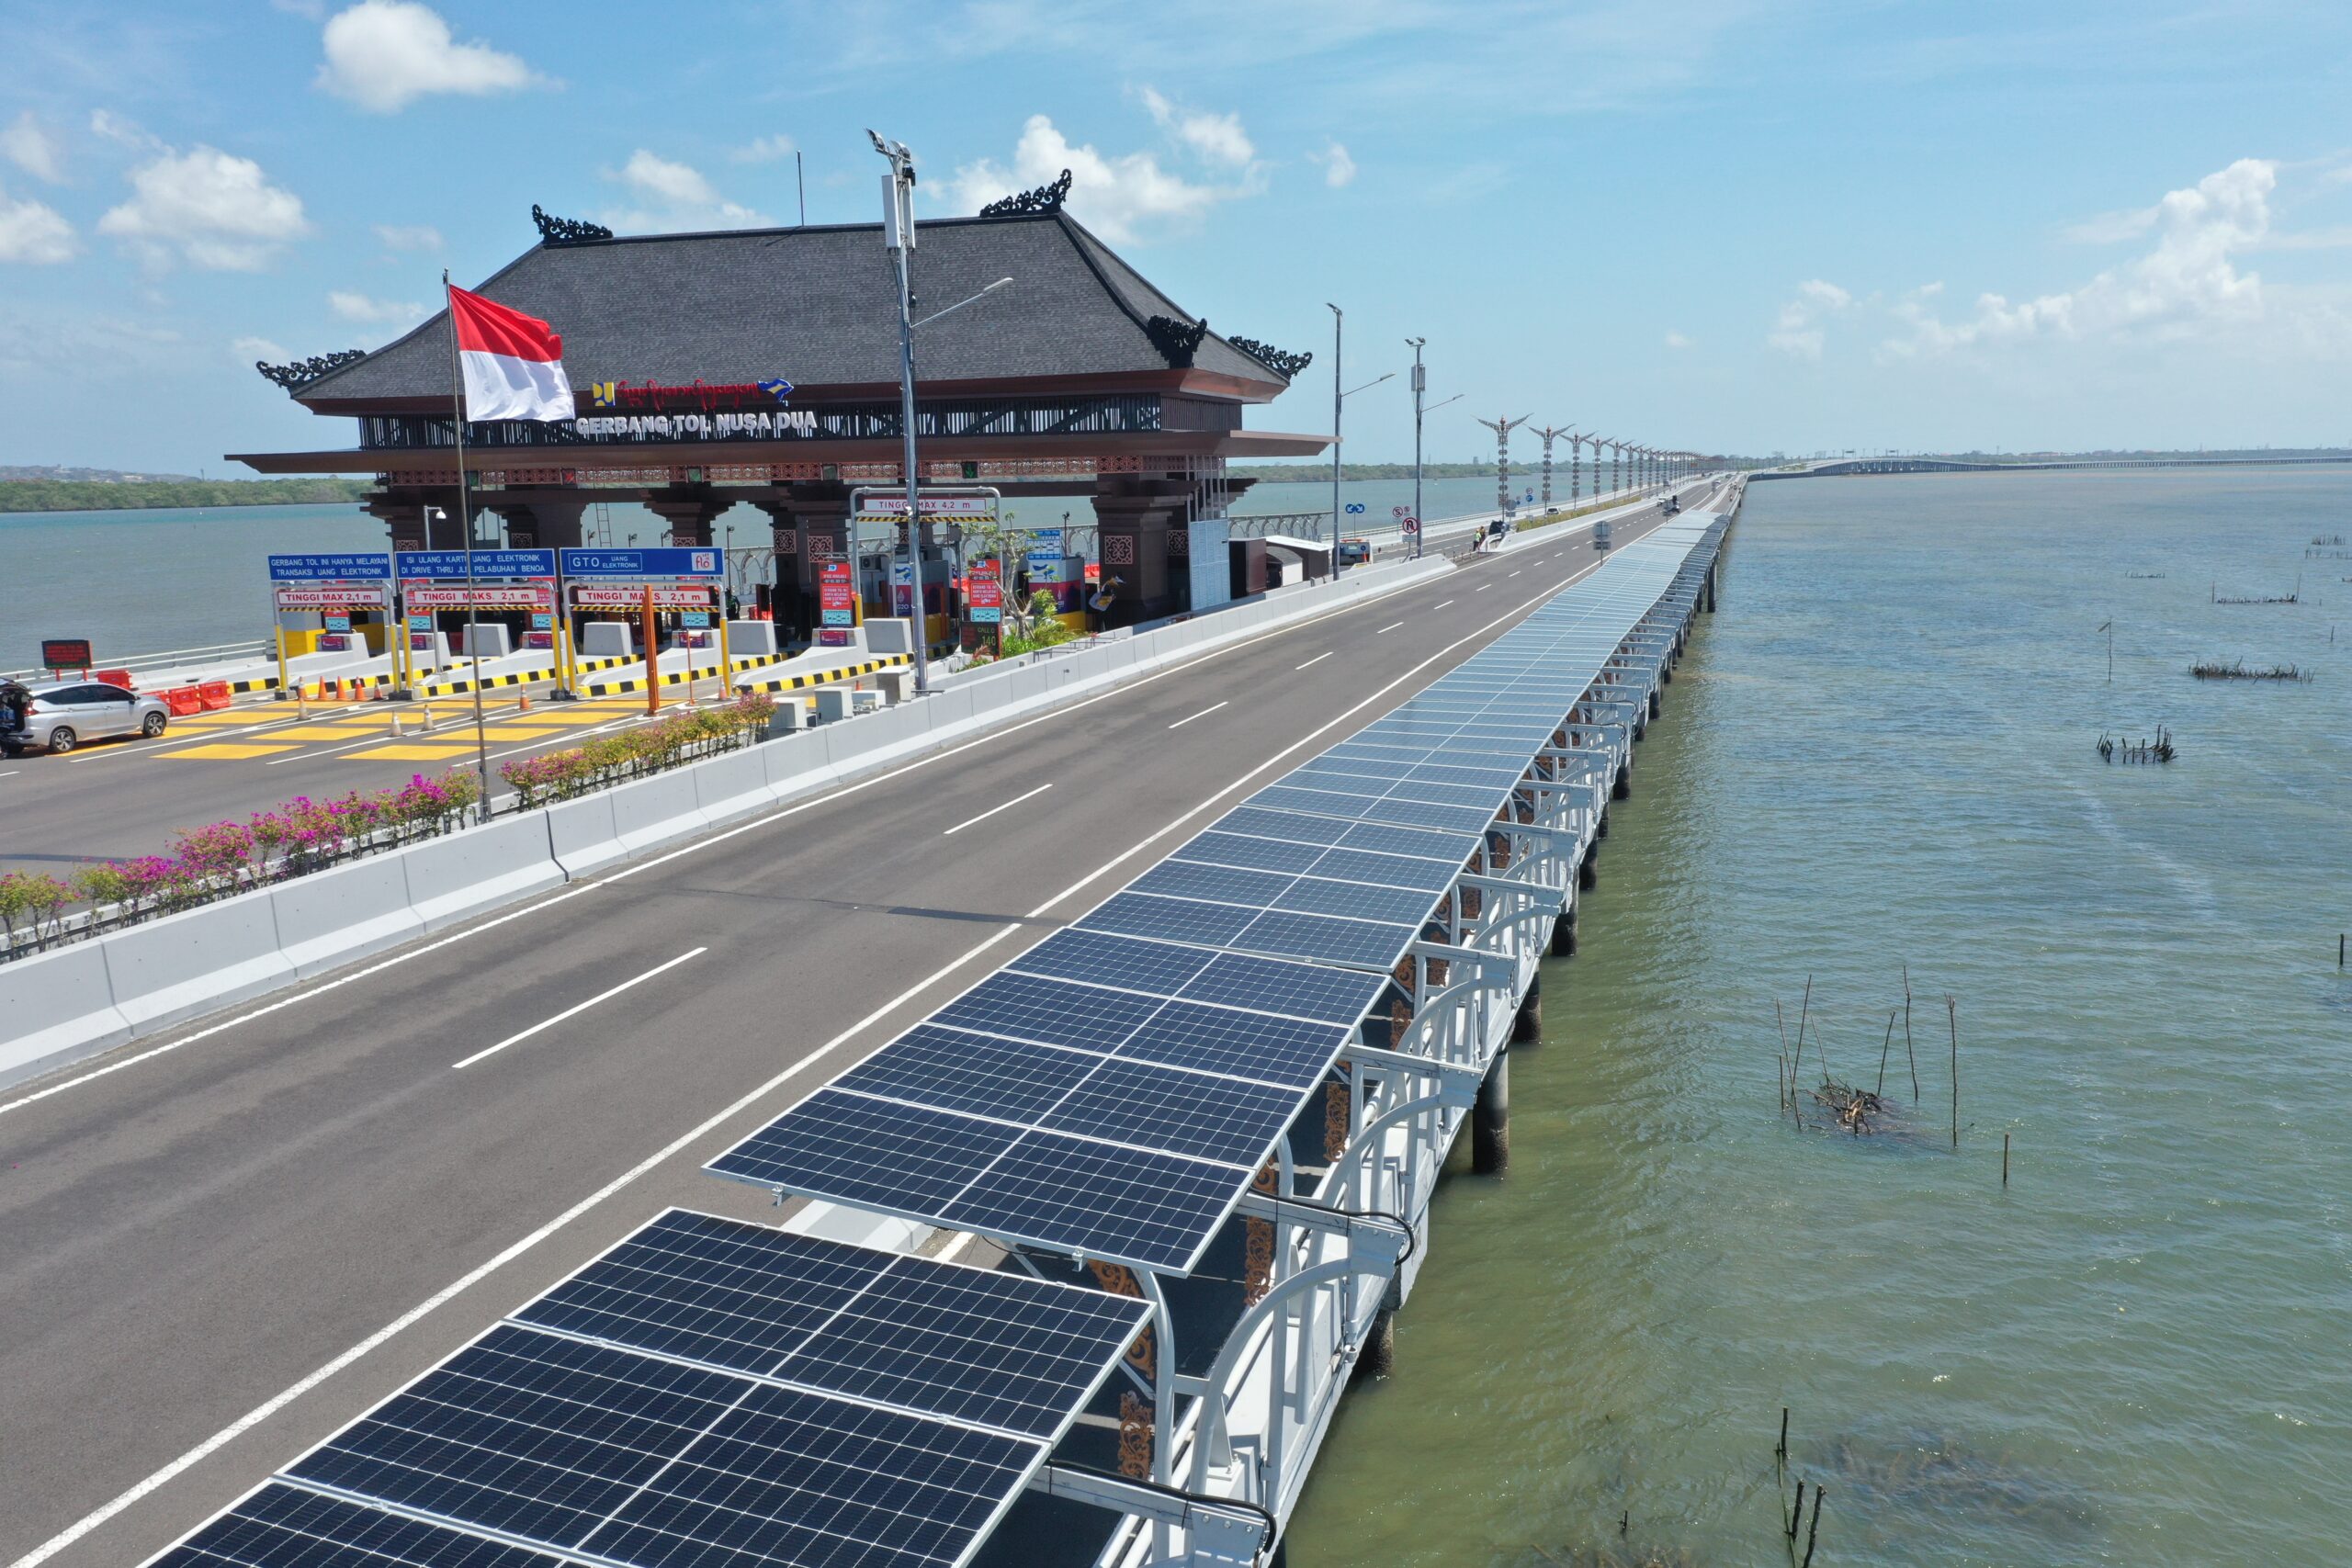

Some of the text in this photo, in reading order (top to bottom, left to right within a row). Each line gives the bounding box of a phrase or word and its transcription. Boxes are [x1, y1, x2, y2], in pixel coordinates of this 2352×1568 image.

[575, 411, 818, 434] GERBANG TOL NUSA DUA
[879, 501, 908, 509] TINGG
[917, 501, 936, 509] MAX
[942, 501, 955, 510] 4,2
[270, 558, 303, 567] GERBANG
[306, 558, 319, 566] TOL
[321, 558, 329, 566] INI
[331, 558, 354, 566] HANYA
[406, 556, 414, 564] ISI
[418, 556, 442, 564] ULANG
[472, 555, 492, 563] UANG
[497, 554, 540, 562] ELEKTRONIK
[572, 557, 600, 568] GTO
[276, 569, 313, 577] TRANSAKSI
[341, 568, 383, 576] ELEKTRONIK
[412, 566, 432, 574] DRIVE
[436, 566, 454, 574] THRU
[474, 565, 516, 573] PELABUHAN
[521, 564, 546, 572] BENOA
[286, 593, 320, 602] TINGGI
[322, 592, 345, 601] MAX
[346, 592, 360, 602] 2,1
[422, 592, 456, 602] TINGGI
[462, 592, 494, 601] MAKS.
[502, 592, 514, 602] 2,1
[586, 592, 622, 601] TINGGI
[629, 592, 663, 601] MAS.
[671, 592, 685, 602] 2,1
